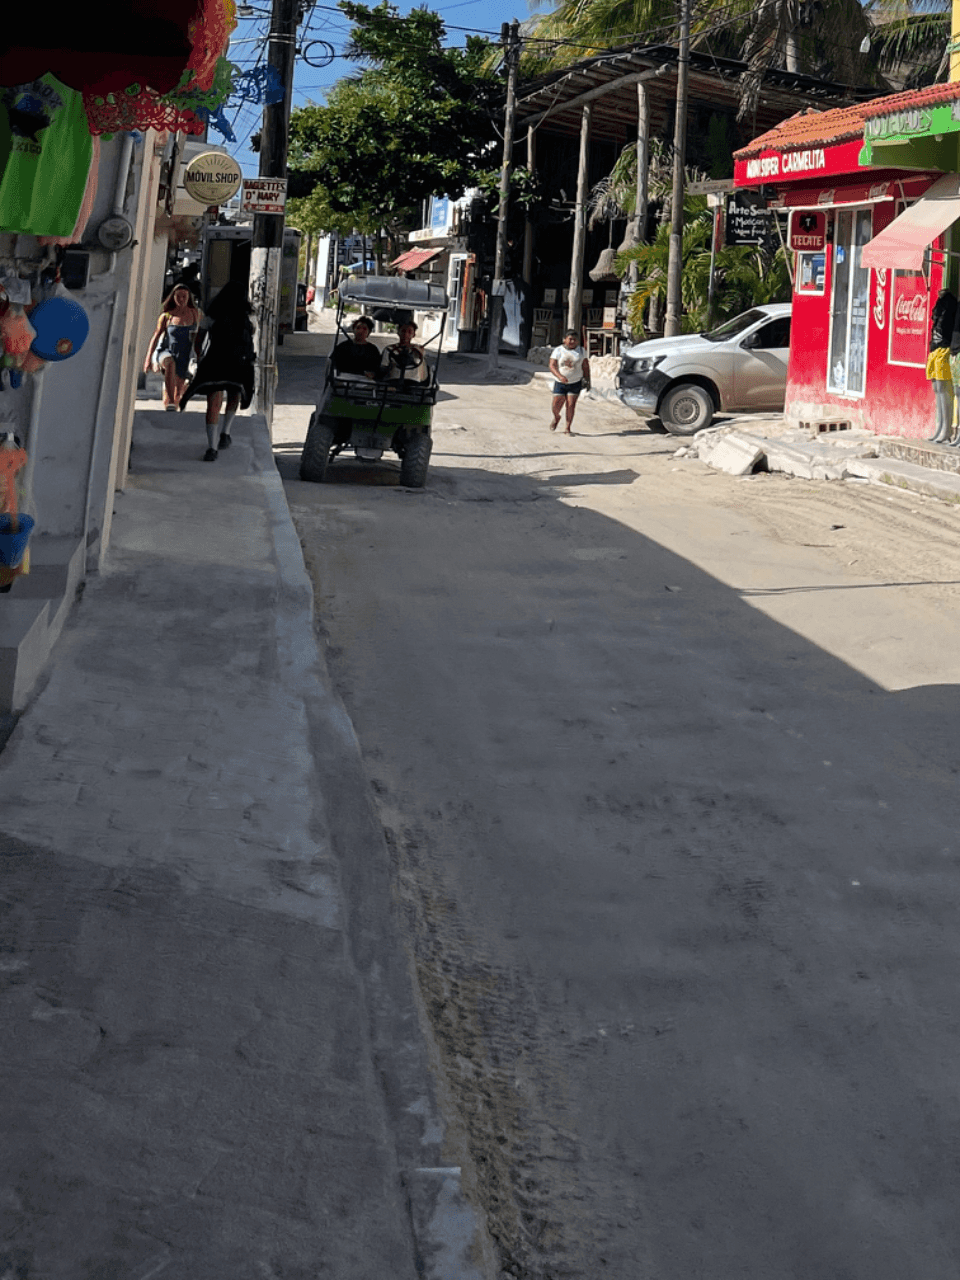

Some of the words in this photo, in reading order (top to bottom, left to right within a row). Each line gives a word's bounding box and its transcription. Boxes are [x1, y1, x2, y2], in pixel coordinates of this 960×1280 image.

[761, 156, 779, 177] SUPER
[782, 148, 826, 174] CARMELITA
[215, 172, 239, 184] SHOP
[244, 179, 286, 190] BAGUETTES
[792, 235, 823, 246] TECATE
